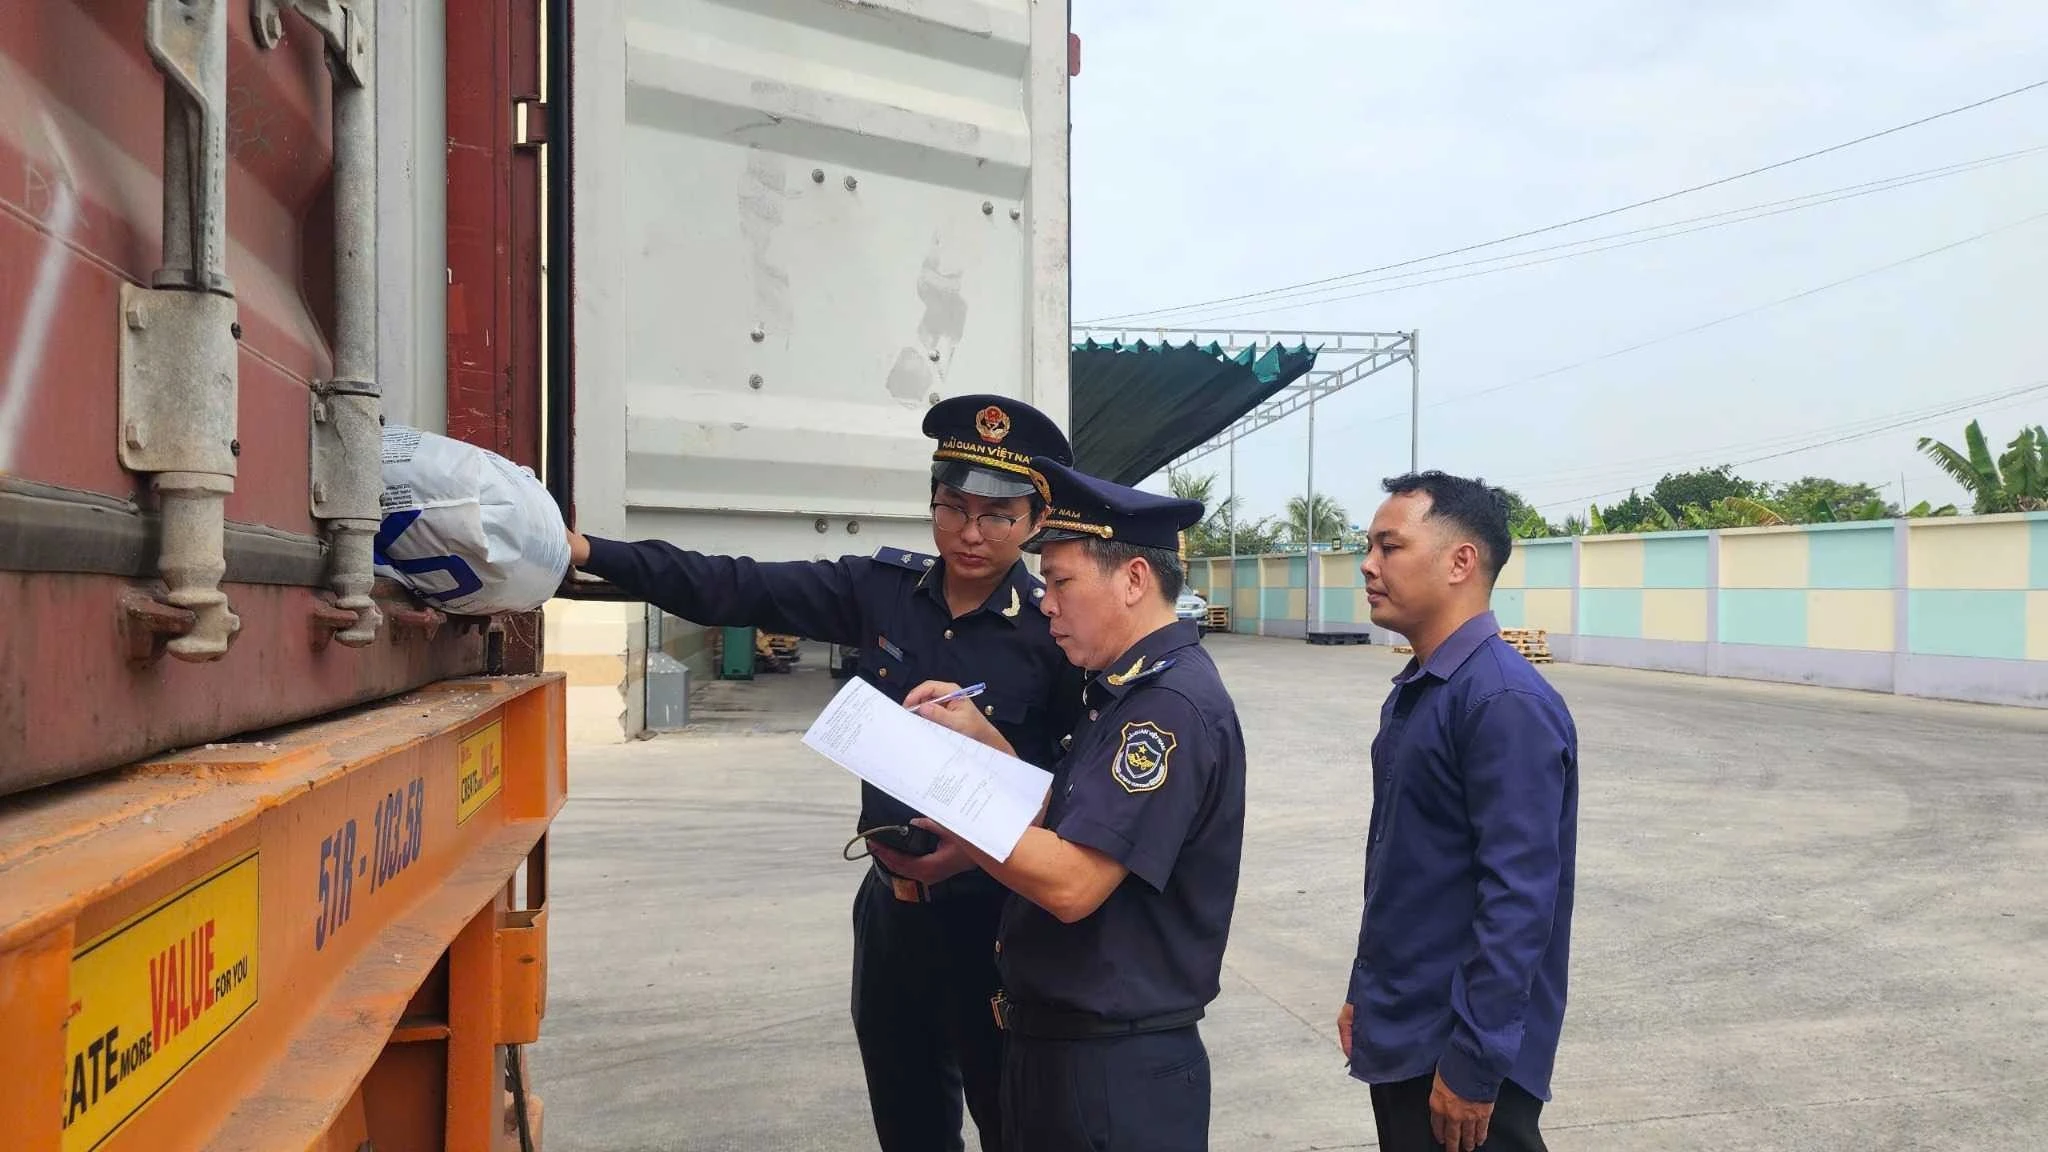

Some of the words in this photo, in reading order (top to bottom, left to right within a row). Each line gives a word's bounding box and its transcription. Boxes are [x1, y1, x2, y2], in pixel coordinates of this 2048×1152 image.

[957, 442, 985, 454] QUAN
[1014, 453, 1033, 465] NA
[315, 819, 357, 951] 51R
[119, 1029, 153, 1082] MORE
[149, 918, 215, 1054] VALUE
[215, 968, 232, 1003] FOR
[232, 952, 248, 988] YOU
